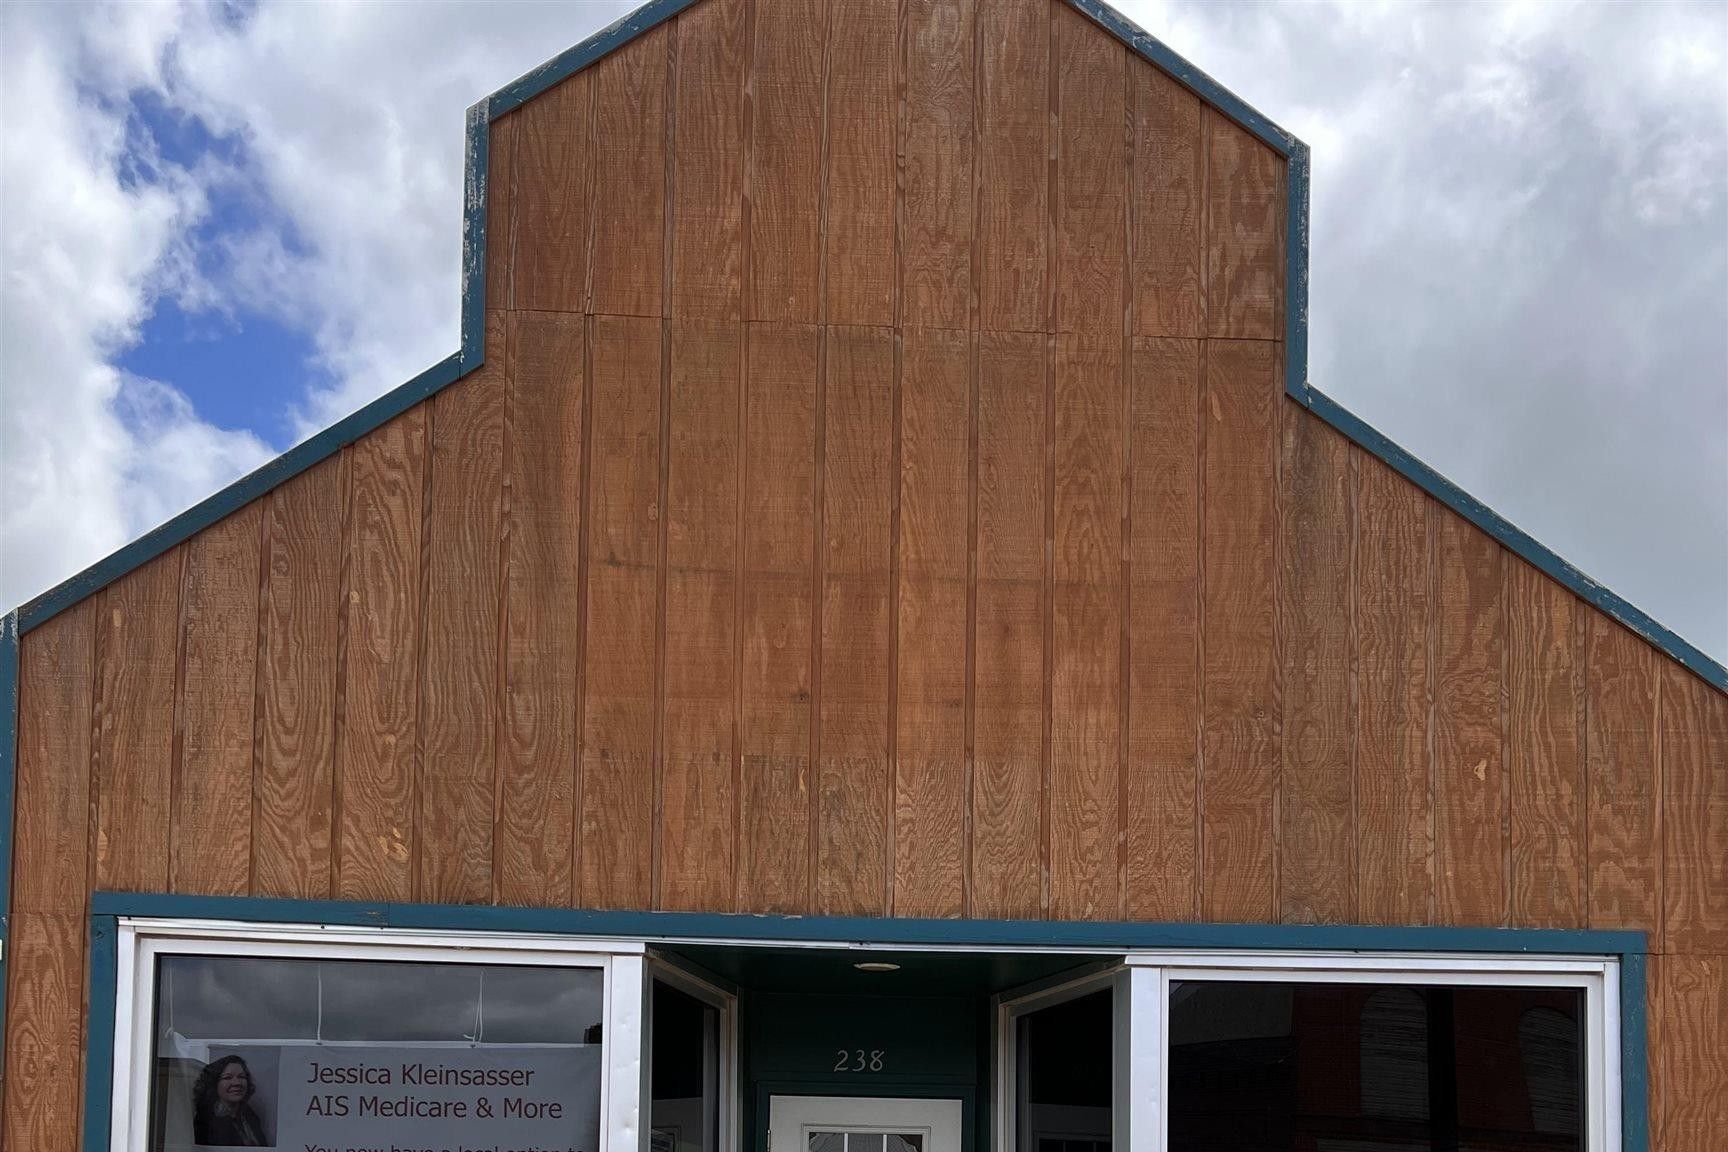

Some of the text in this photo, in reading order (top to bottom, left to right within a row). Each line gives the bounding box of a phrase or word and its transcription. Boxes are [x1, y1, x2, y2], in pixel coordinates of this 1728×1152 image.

[833, 1049, 885, 1072] 238
[307, 1062, 535, 1086] Jessica Kleinsasser
[306, 1095, 562, 1119] AIS Medicare & More
